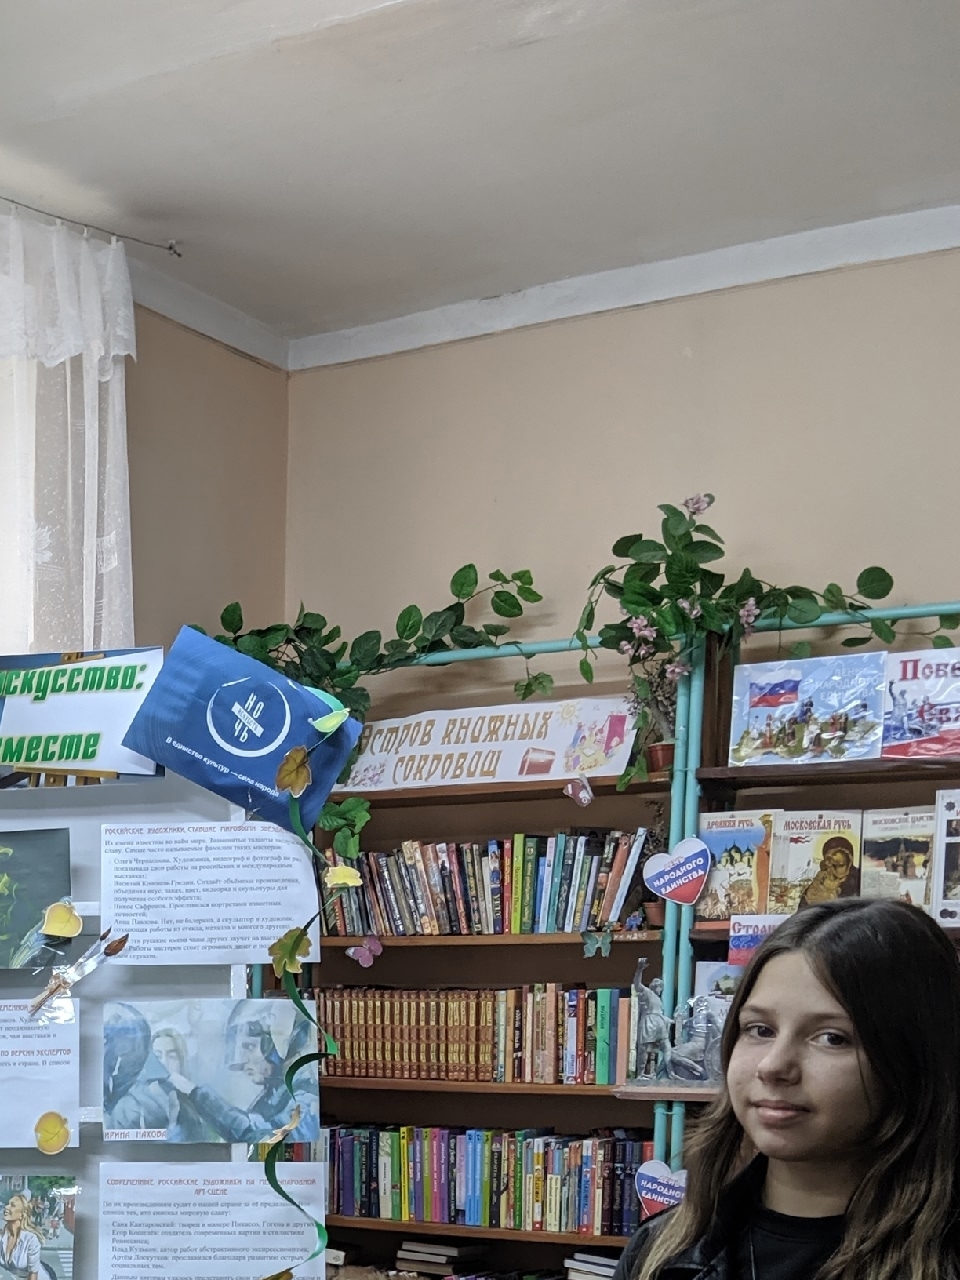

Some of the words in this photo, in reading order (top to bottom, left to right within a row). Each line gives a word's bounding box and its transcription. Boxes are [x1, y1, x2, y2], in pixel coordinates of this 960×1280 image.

[255, 779, 279, 798] народа
[737, 819, 755, 828] РУСЬ
[783, 820, 832, 831] МОСКОВСКАЯ
[834, 819, 852, 830] РУСЬ
[653, 858, 704, 887] НАРОДНОГО
[661, 869, 704, 894] ЕДИНСТВА
[104, 1131, 130, 1139] ИРИНА
